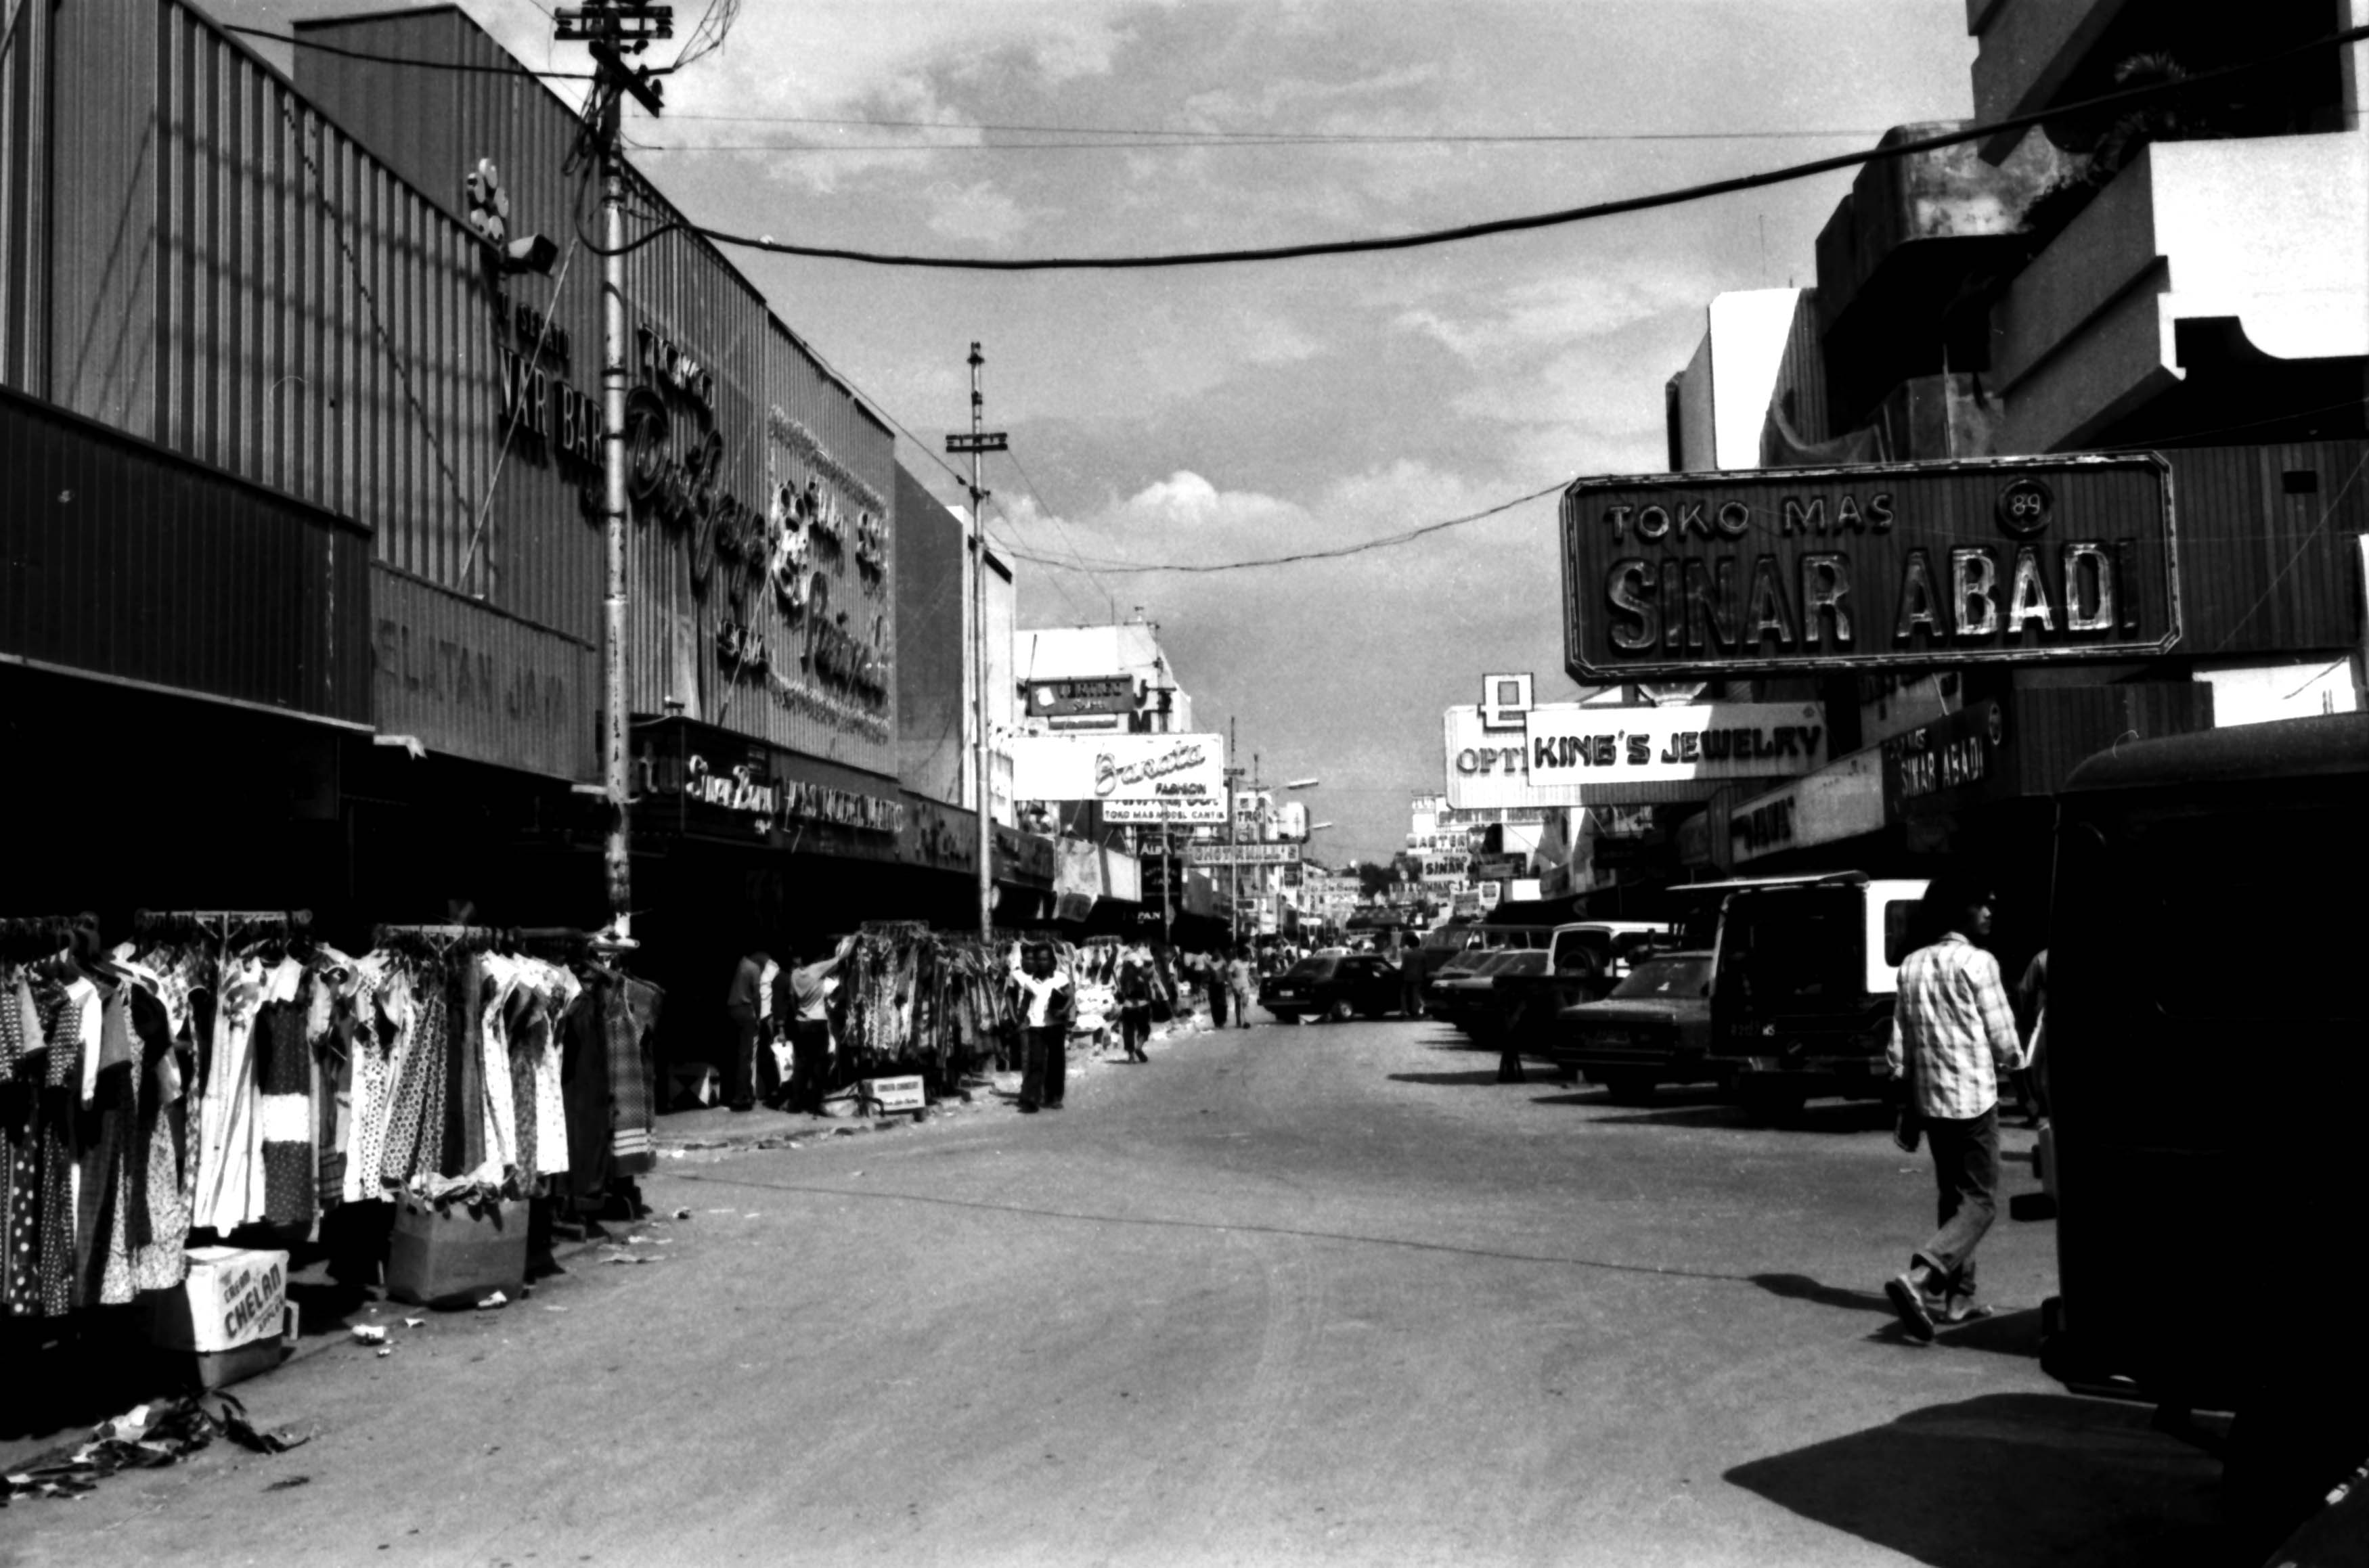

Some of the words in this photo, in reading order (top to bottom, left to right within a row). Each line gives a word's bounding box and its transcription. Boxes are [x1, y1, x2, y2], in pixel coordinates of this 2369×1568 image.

[1606, 499, 1749, 541] TOKO
[1783, 491, 1893, 537] MAS
[2012, 492, 2041, 516] 89
[1606, 551, 1852, 650] SINAR
[1896, 539, 2138, 637] ABADI
[1533, 728, 1652, 769] KING'S
[1660, 724, 1822, 764] JEWELRY
[1425, 861, 1465, 875] SINAR
[224, 1262, 282, 1339] CHELAN
